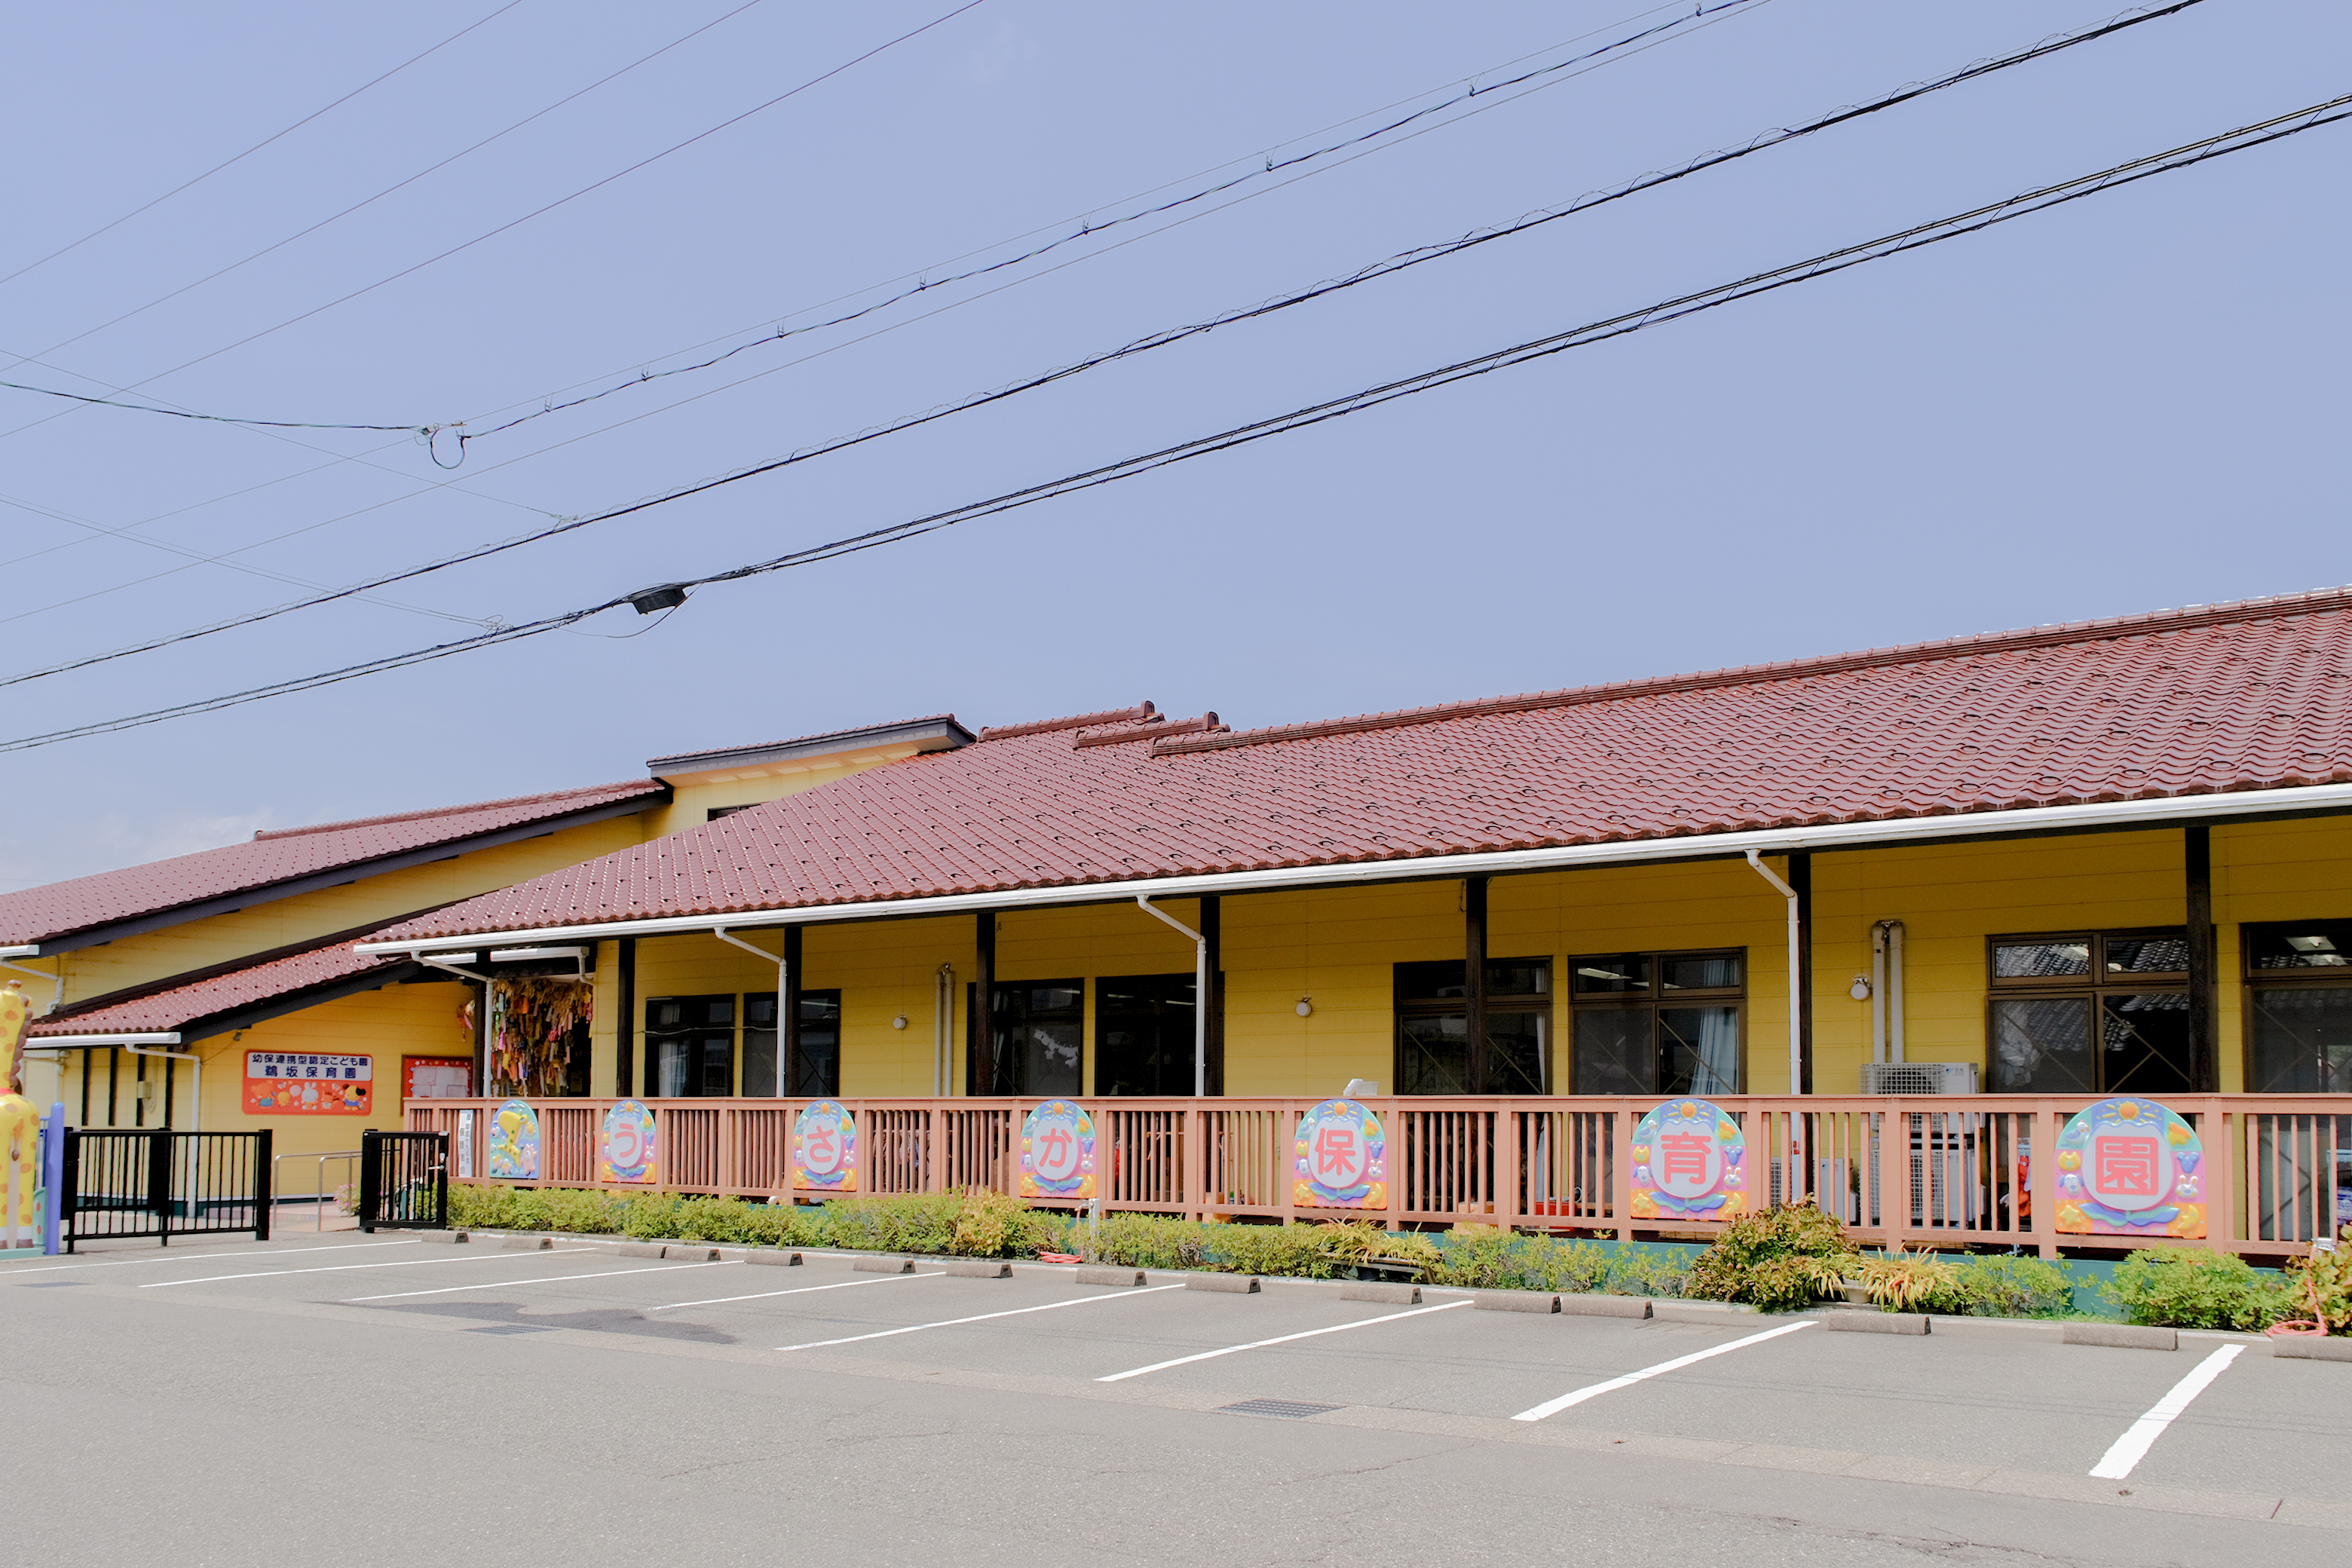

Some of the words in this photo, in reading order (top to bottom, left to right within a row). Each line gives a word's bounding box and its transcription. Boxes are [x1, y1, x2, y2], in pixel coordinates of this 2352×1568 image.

[252, 1054, 368, 1066] 幼保連携型認定こども園
[265, 1065, 356, 1079] 鵜坂保育園
[614, 1123, 637, 1158] う
[807, 1125, 835, 1162] さ
[1039, 1128, 1073, 1168] か
[1314, 1128, 1356, 1176] 保
[1660, 1131, 1711, 1184] 育
[2096, 1135, 2159, 1196] 園
